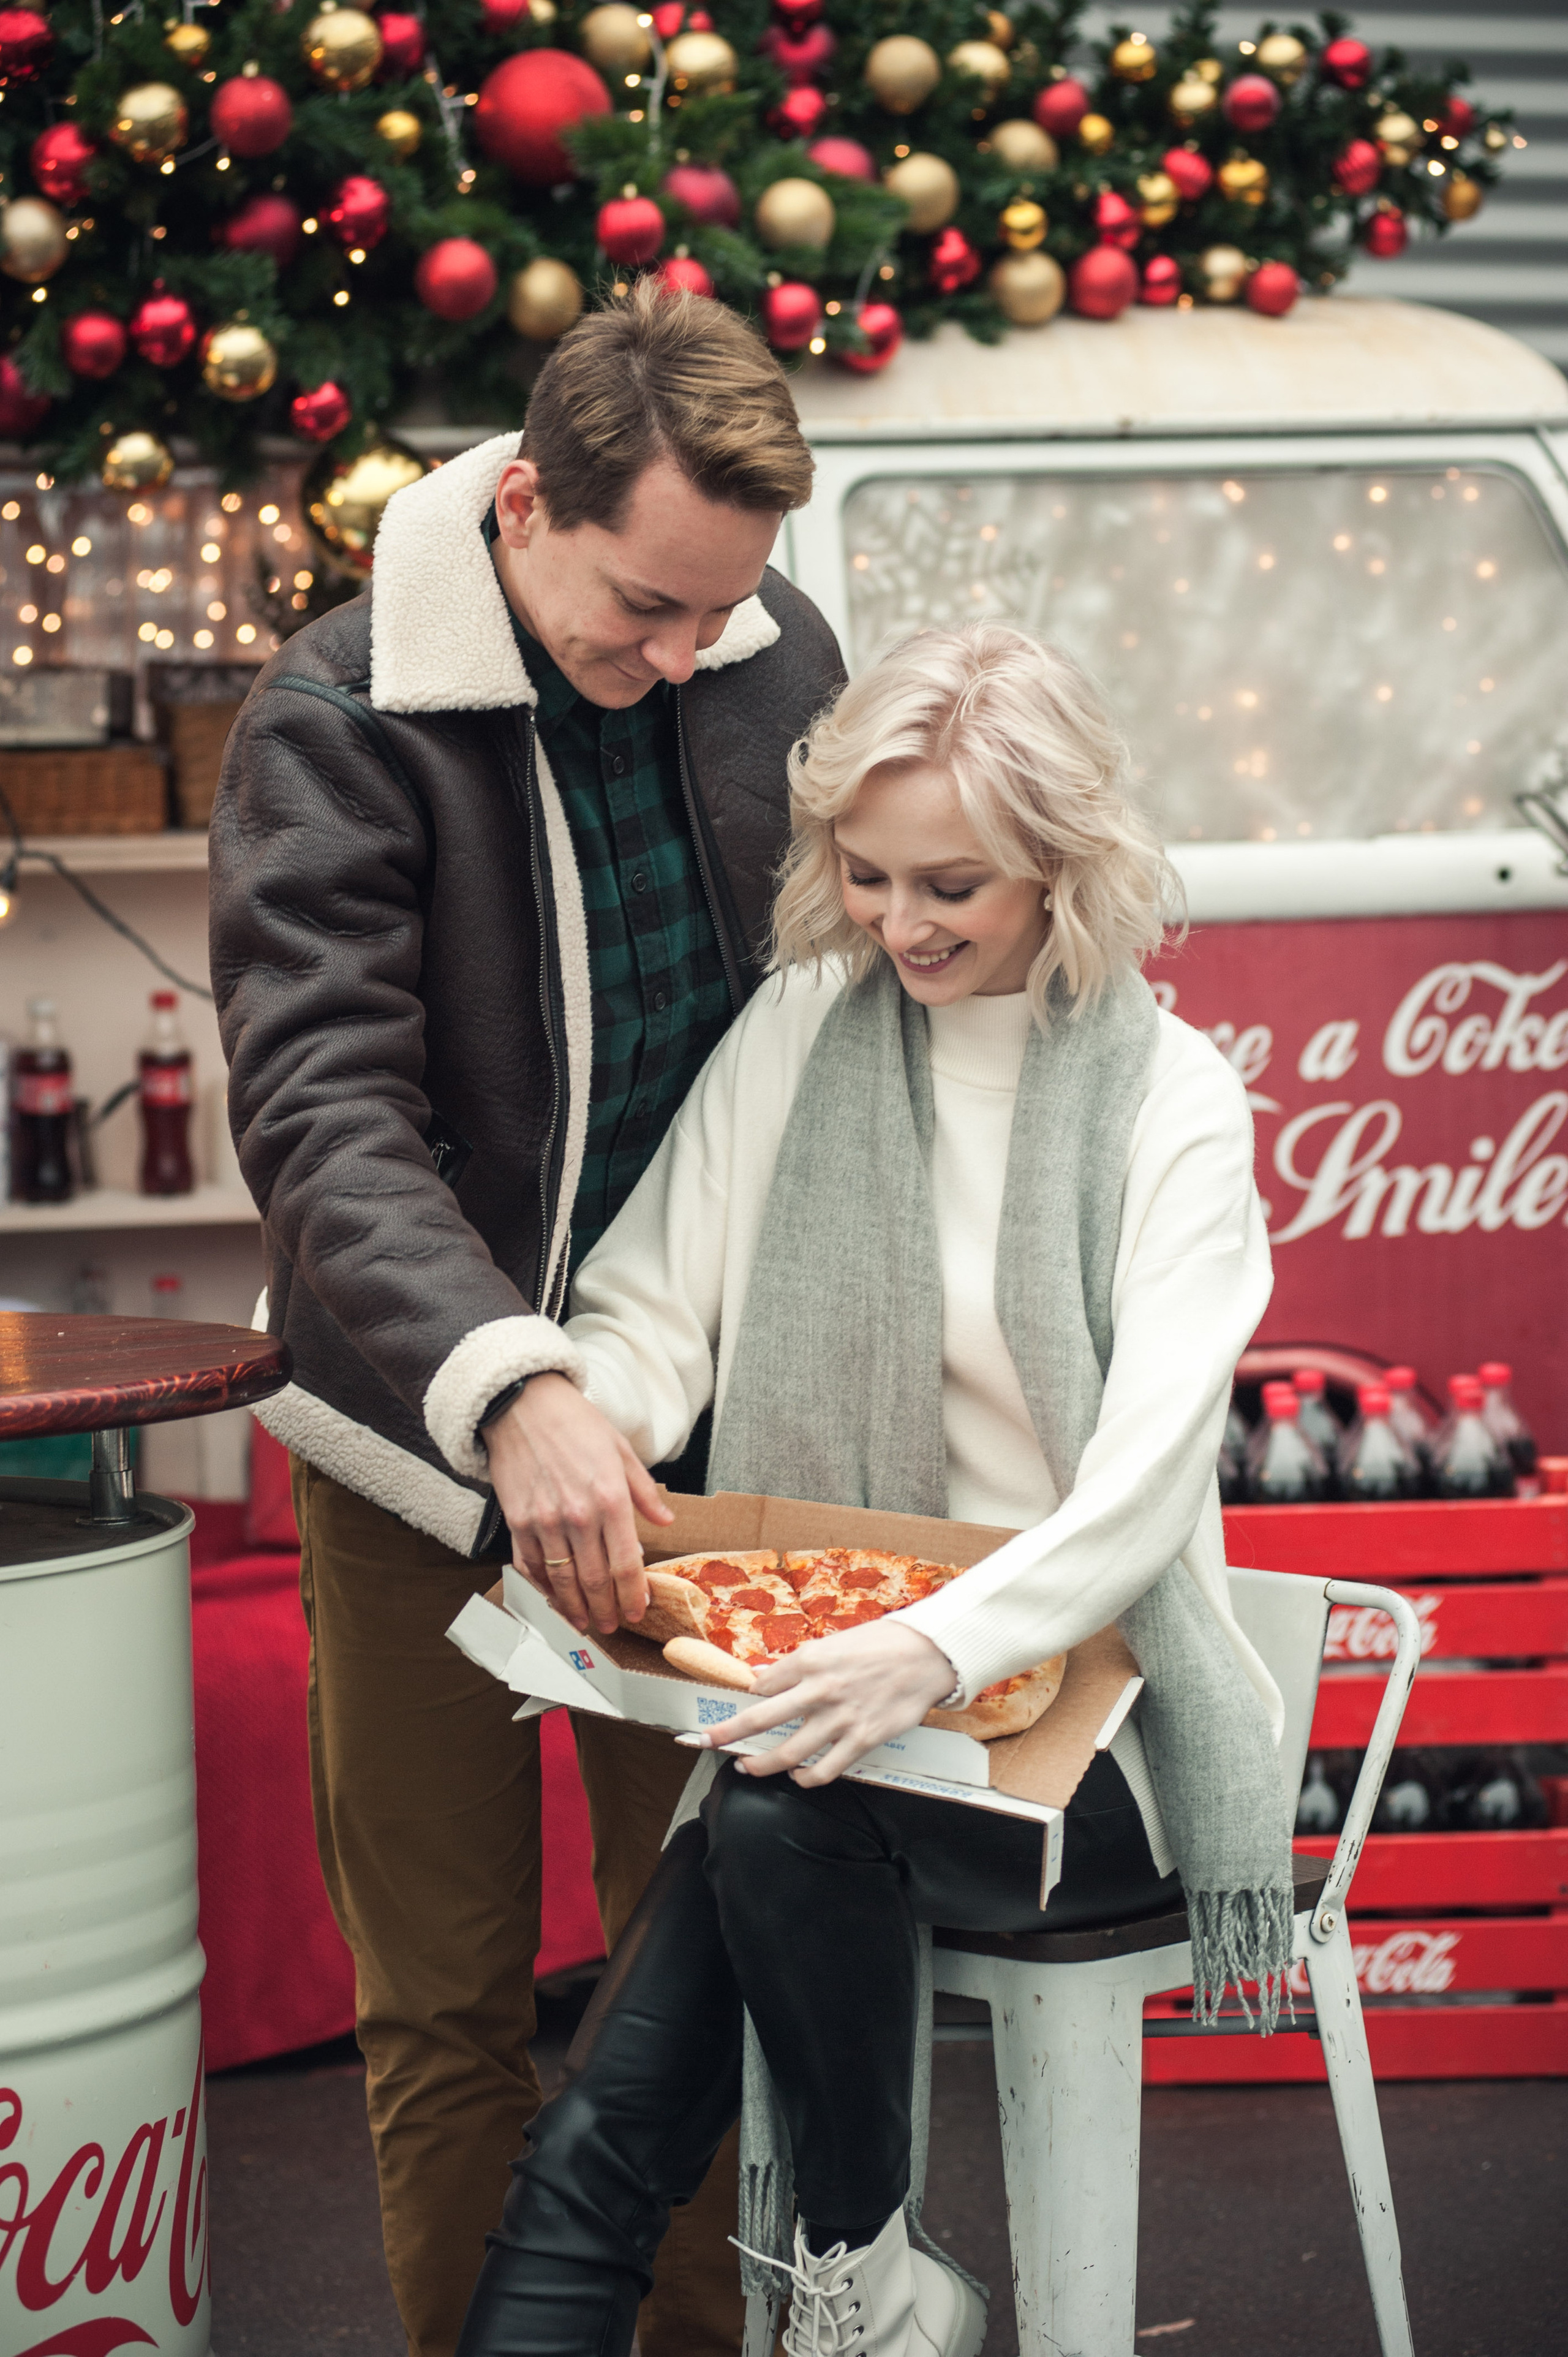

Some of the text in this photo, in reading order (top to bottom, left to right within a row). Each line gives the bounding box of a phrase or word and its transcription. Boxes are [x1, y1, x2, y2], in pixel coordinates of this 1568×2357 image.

[1298, 1019, 1359, 1083] a
[1382, 959, 1568, 1078] Coke
[1268, 1089, 1568, 1246] Smile
